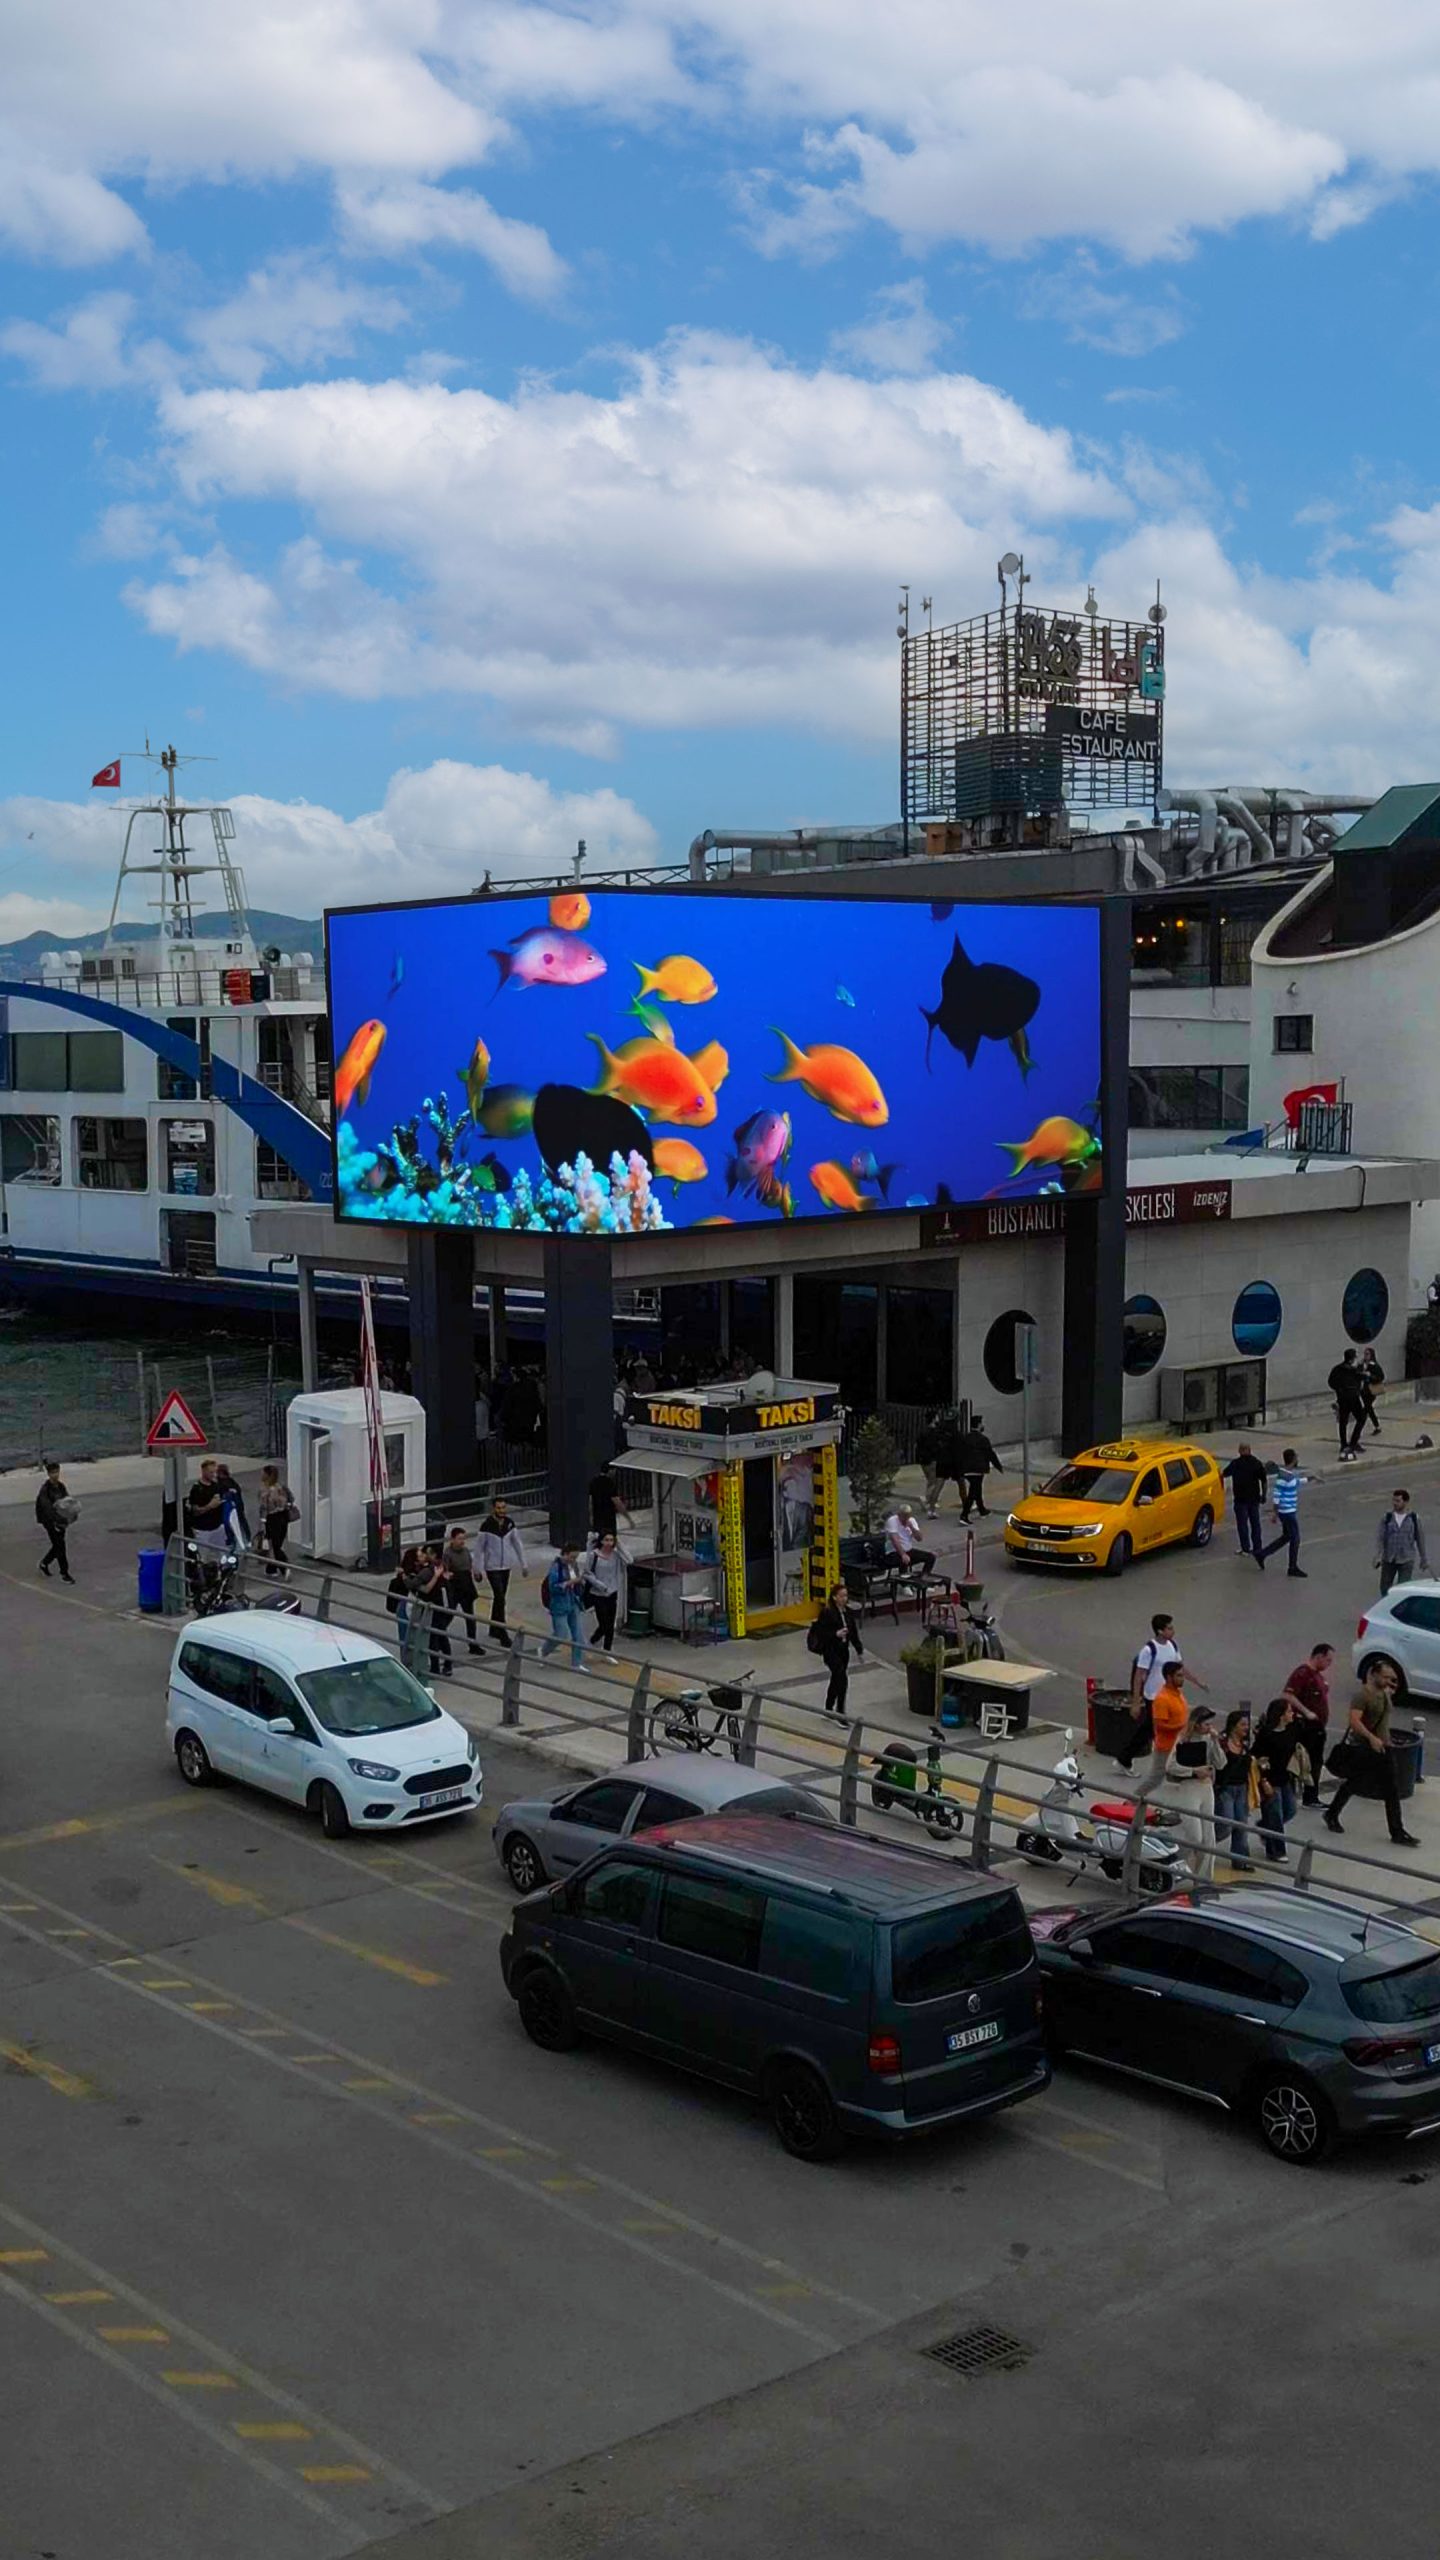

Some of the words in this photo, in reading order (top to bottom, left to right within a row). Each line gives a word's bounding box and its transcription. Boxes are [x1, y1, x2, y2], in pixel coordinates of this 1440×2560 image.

[1080, 709, 1127, 733] CAFE
[1061, 733, 1157, 760] ESTAURANT
[988, 1203, 1056, 1235] BOSTANLI
[1125, 1189, 1175, 1222] SKELESİ
[648, 1403, 702, 1430] TAKSİ
[755, 1396, 815, 1428] TAKSİ
[951, 2034, 963, 2048] 35
